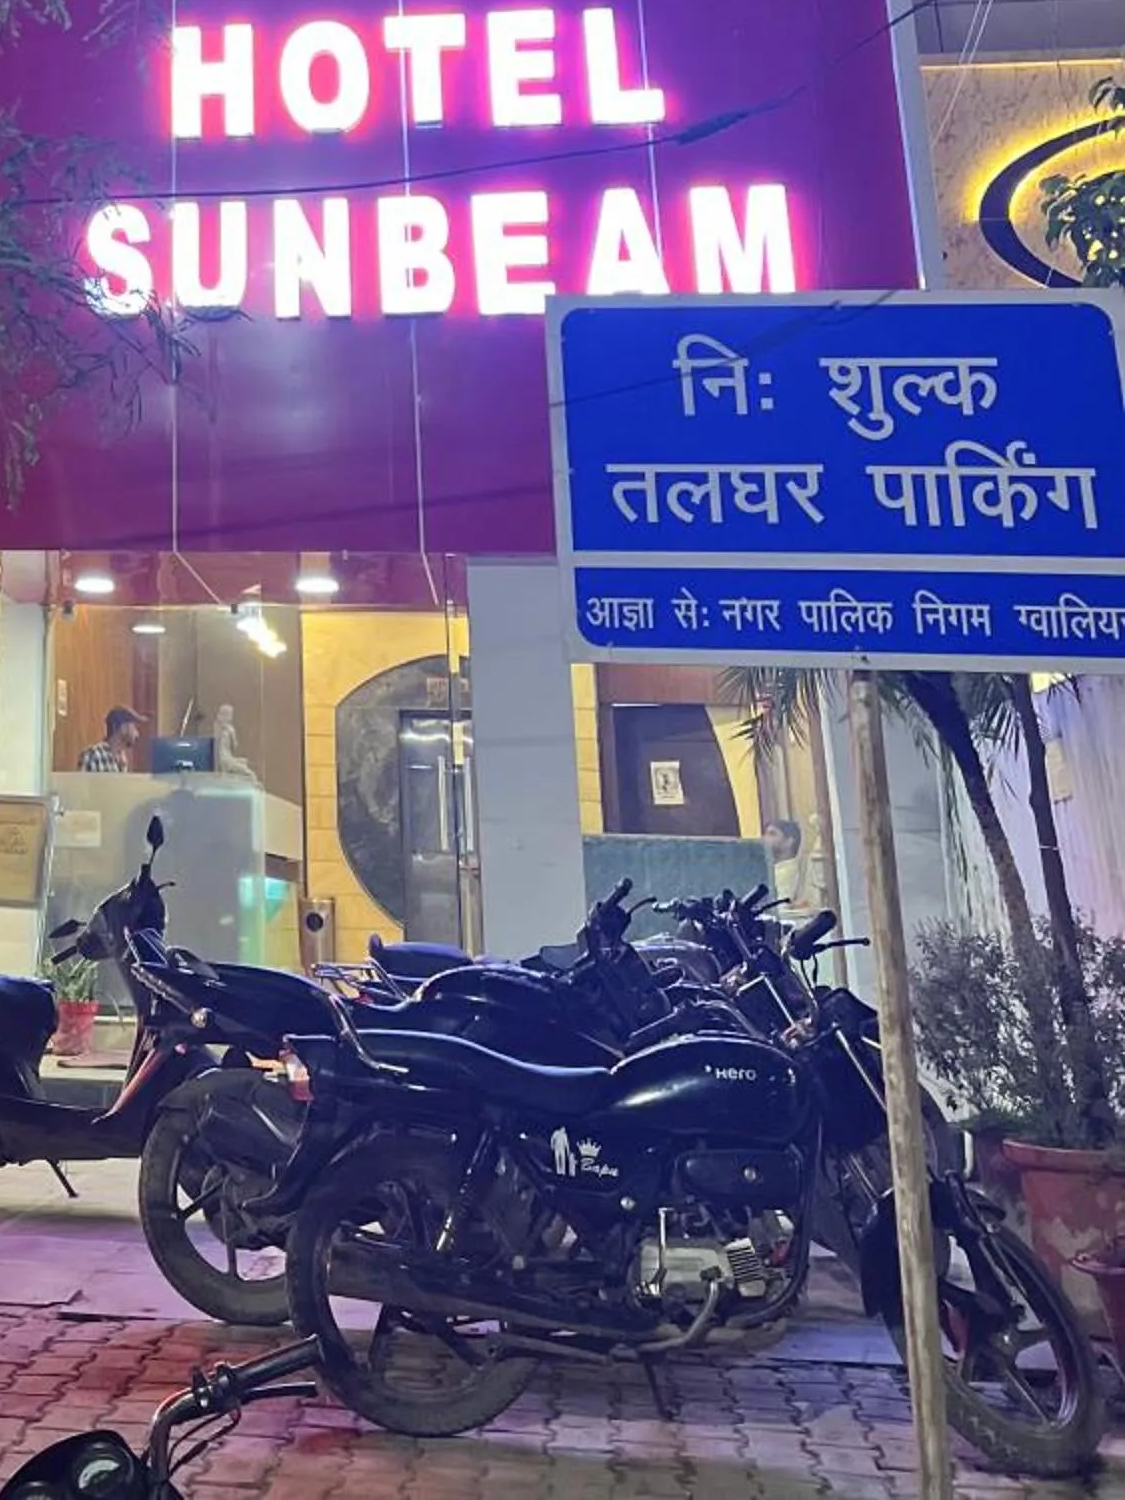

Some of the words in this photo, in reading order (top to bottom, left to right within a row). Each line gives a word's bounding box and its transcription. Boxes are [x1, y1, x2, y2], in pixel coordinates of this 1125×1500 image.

[170, 7, 665, 138] HOTEL
[84, 184, 798, 317] SUNBEAM
[819, 357, 997, 440] शुल्क
[605, 463, 825, 524] तलघर
[866, 440, 1097, 529] पार्किंग
[586, 596, 654, 631] आज्ञा
[719, 597, 781, 632] नगर
[798, 588, 893, 634] पालिक
[913, 589, 992, 637] निगम
[716, 1067, 757, 1081] Hero
